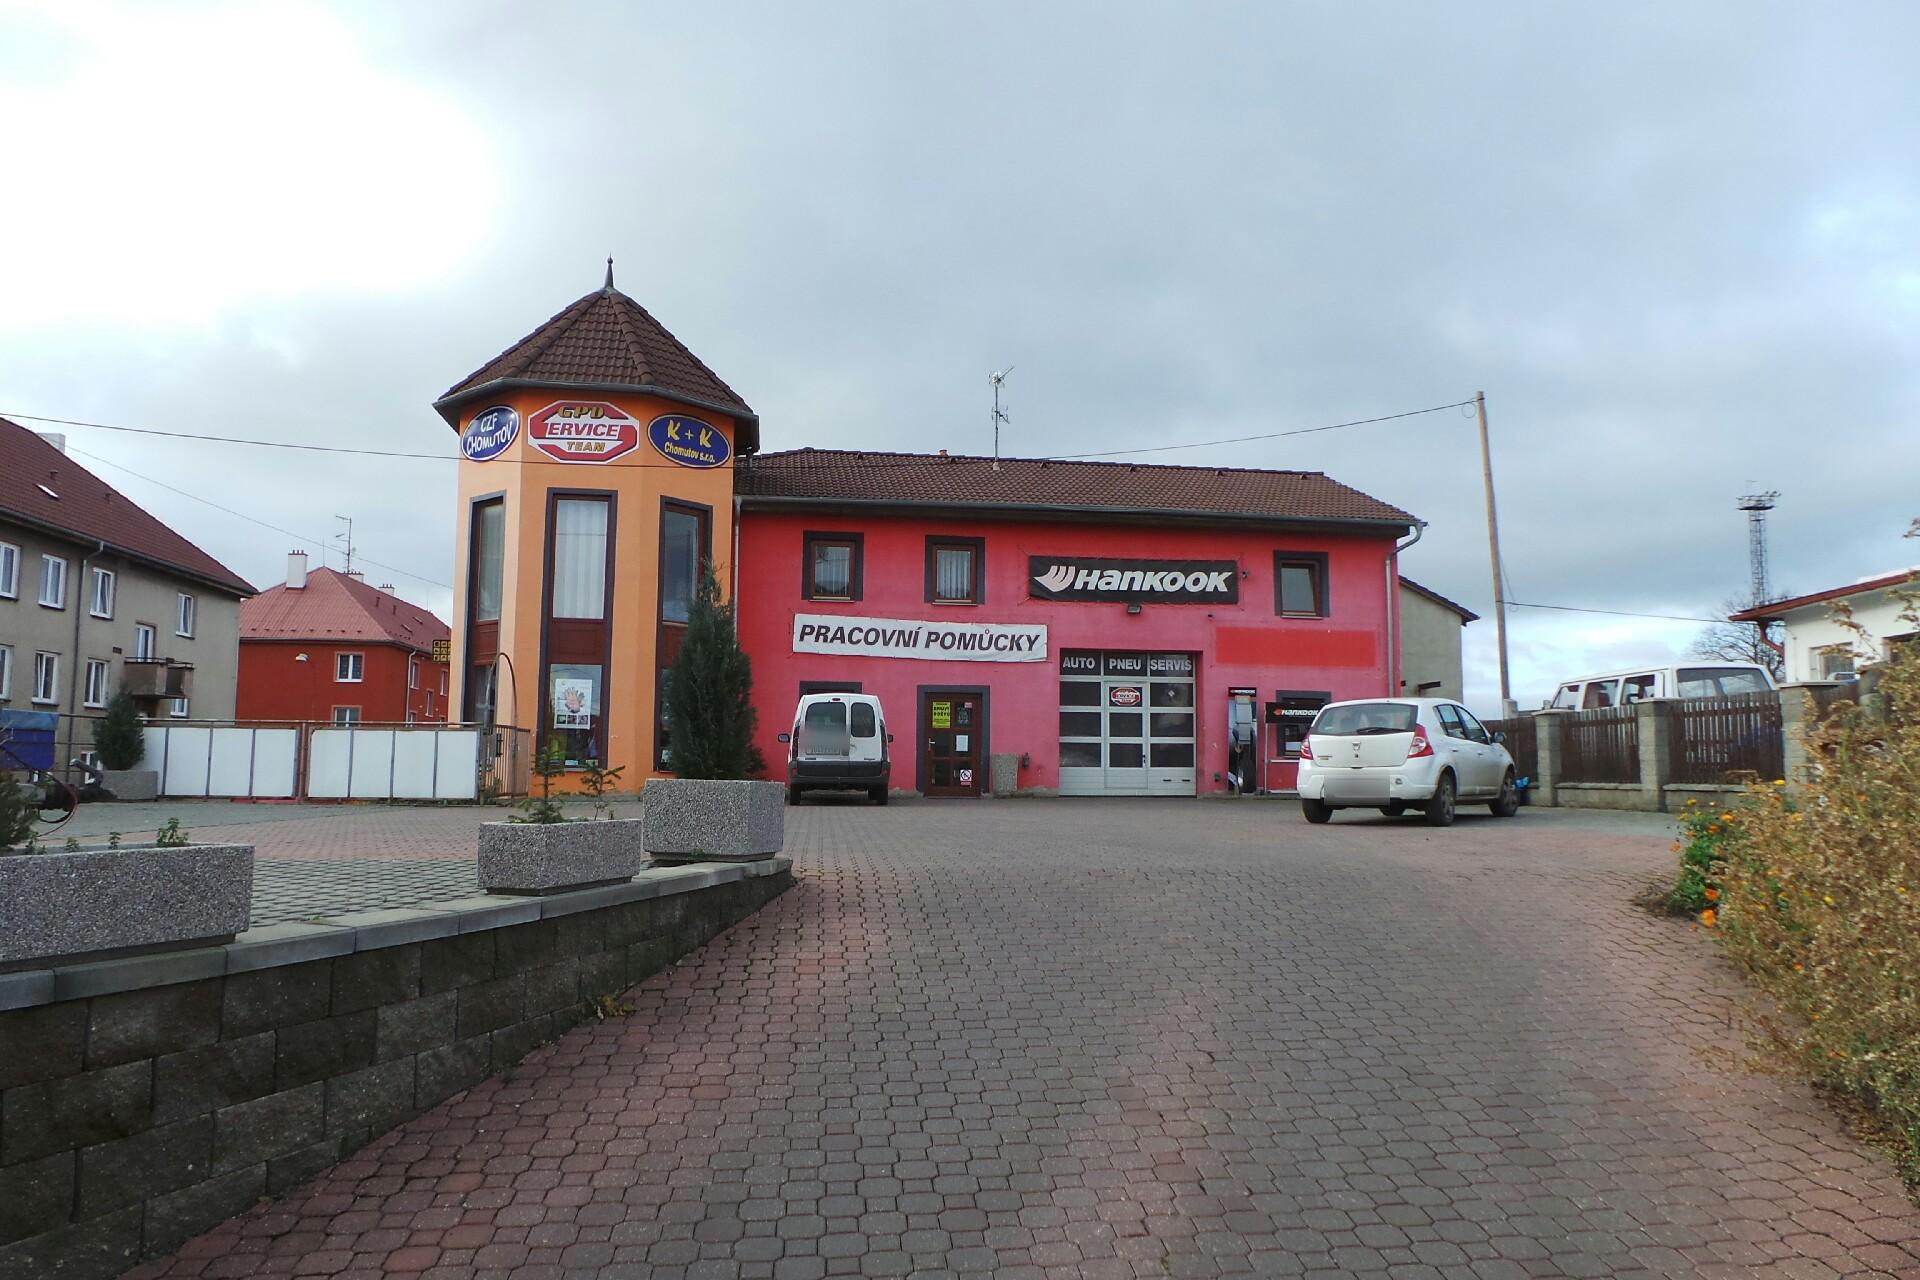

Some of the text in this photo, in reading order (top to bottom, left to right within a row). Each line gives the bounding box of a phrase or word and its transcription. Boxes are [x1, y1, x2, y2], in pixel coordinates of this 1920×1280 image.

[480, 412, 498, 433] CZF
[466, 420, 513, 455] CHOMUTOV
[667, 419, 681, 441] K
[699, 427, 713, 448] K
[567, 441, 605, 452] TEAM
[664, 441, 700, 460] Chomutov
[799, 624, 1040, 652] PRACOVNÍ POMŮCKY
[1063, 657, 1192, 671] AUTO PNEU SERVIS
